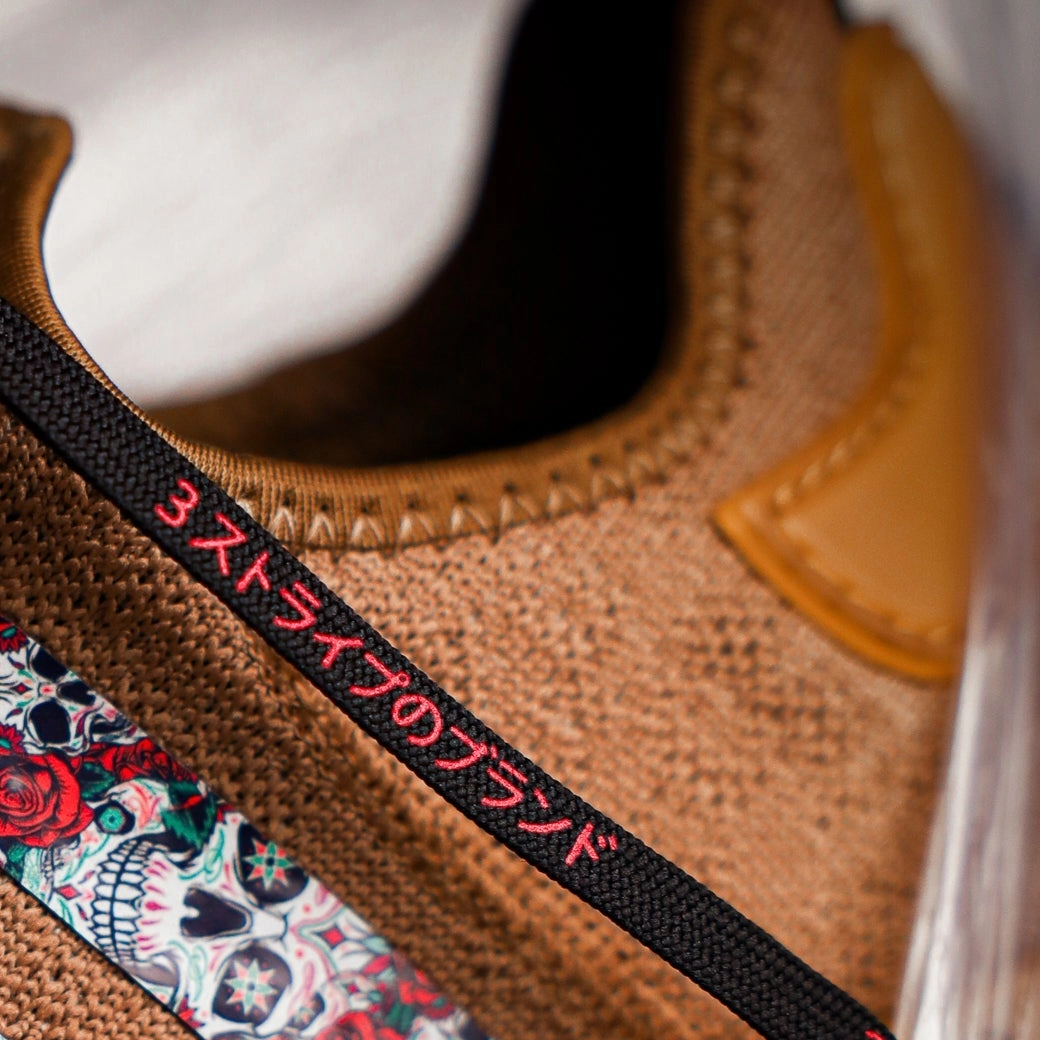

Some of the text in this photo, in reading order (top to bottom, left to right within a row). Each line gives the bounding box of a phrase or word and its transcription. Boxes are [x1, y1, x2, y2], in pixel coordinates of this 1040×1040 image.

[154, 478, 617, 867] 3ストライプのブランド
